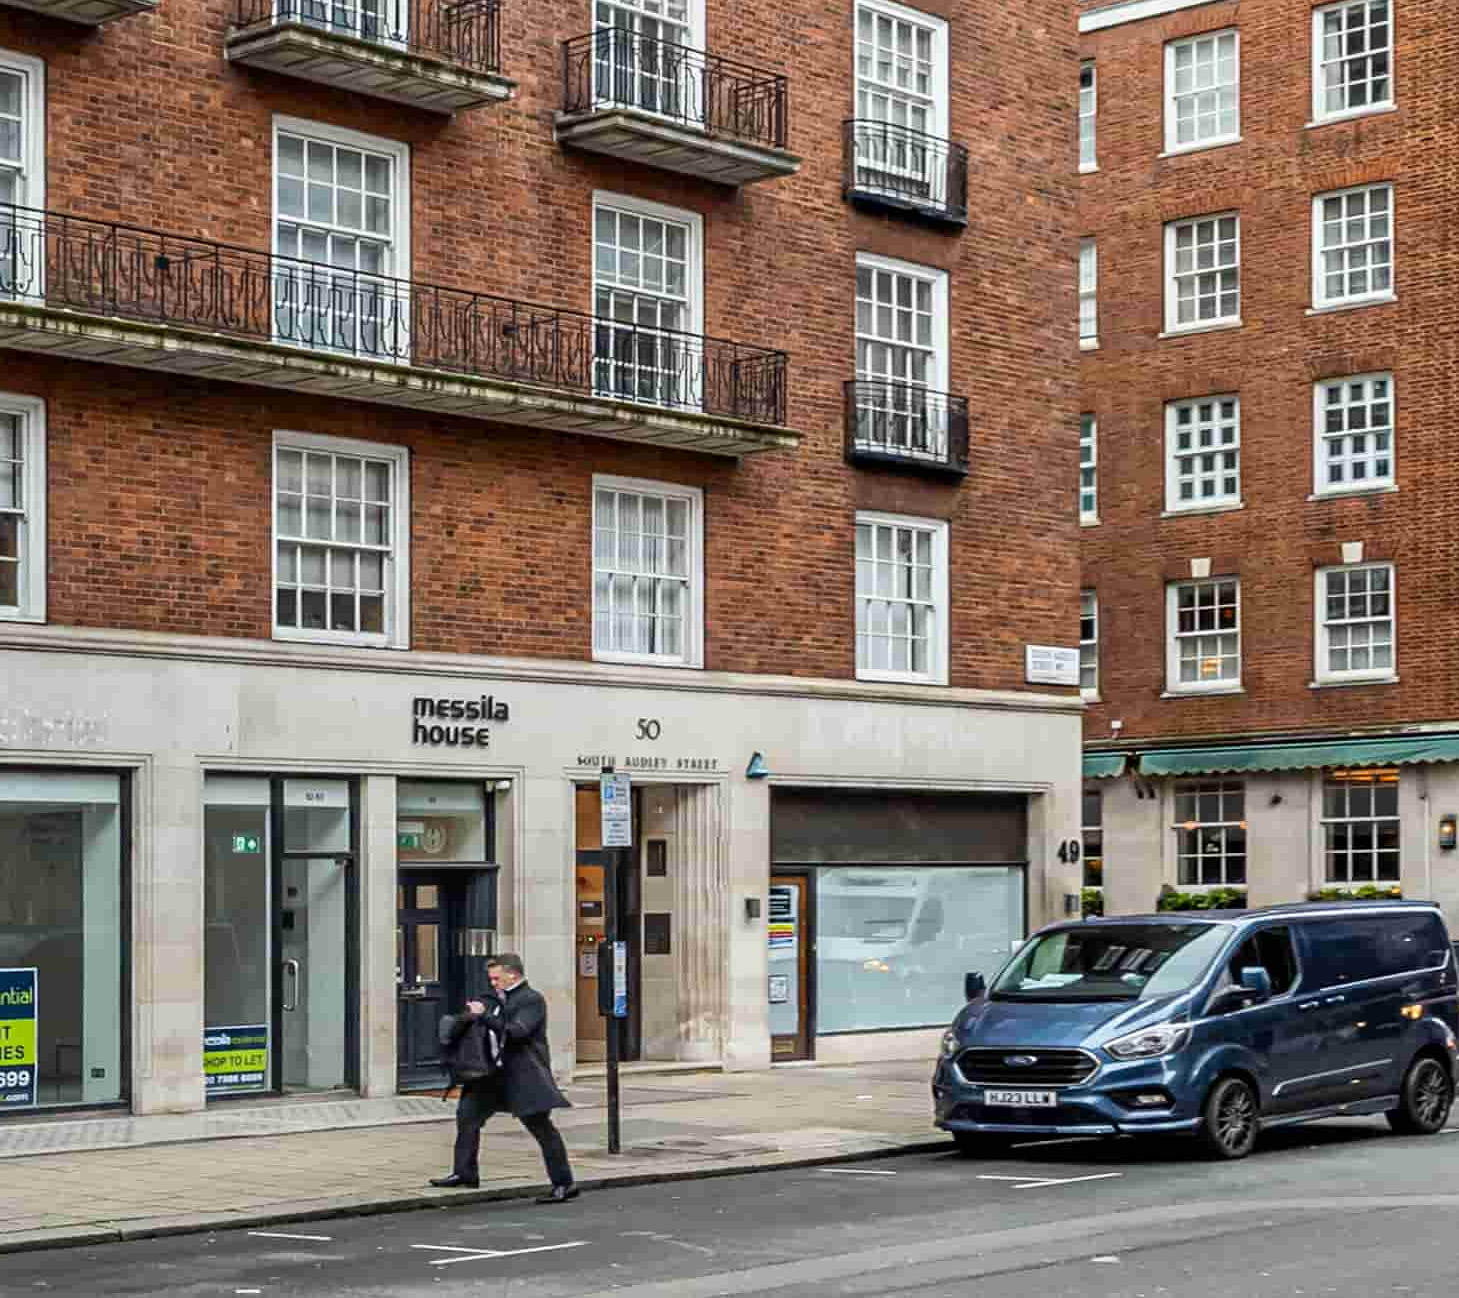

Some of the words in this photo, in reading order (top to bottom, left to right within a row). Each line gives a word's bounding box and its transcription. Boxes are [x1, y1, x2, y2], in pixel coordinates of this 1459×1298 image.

[412, 694, 510, 721] messila
[412, 716, 489, 746] house
[635, 717, 661, 740] 50
[577, 755, 616, 766] SOUTH
[677, 758, 718, 770] STREET
[1056, 839, 1080, 864] 49
